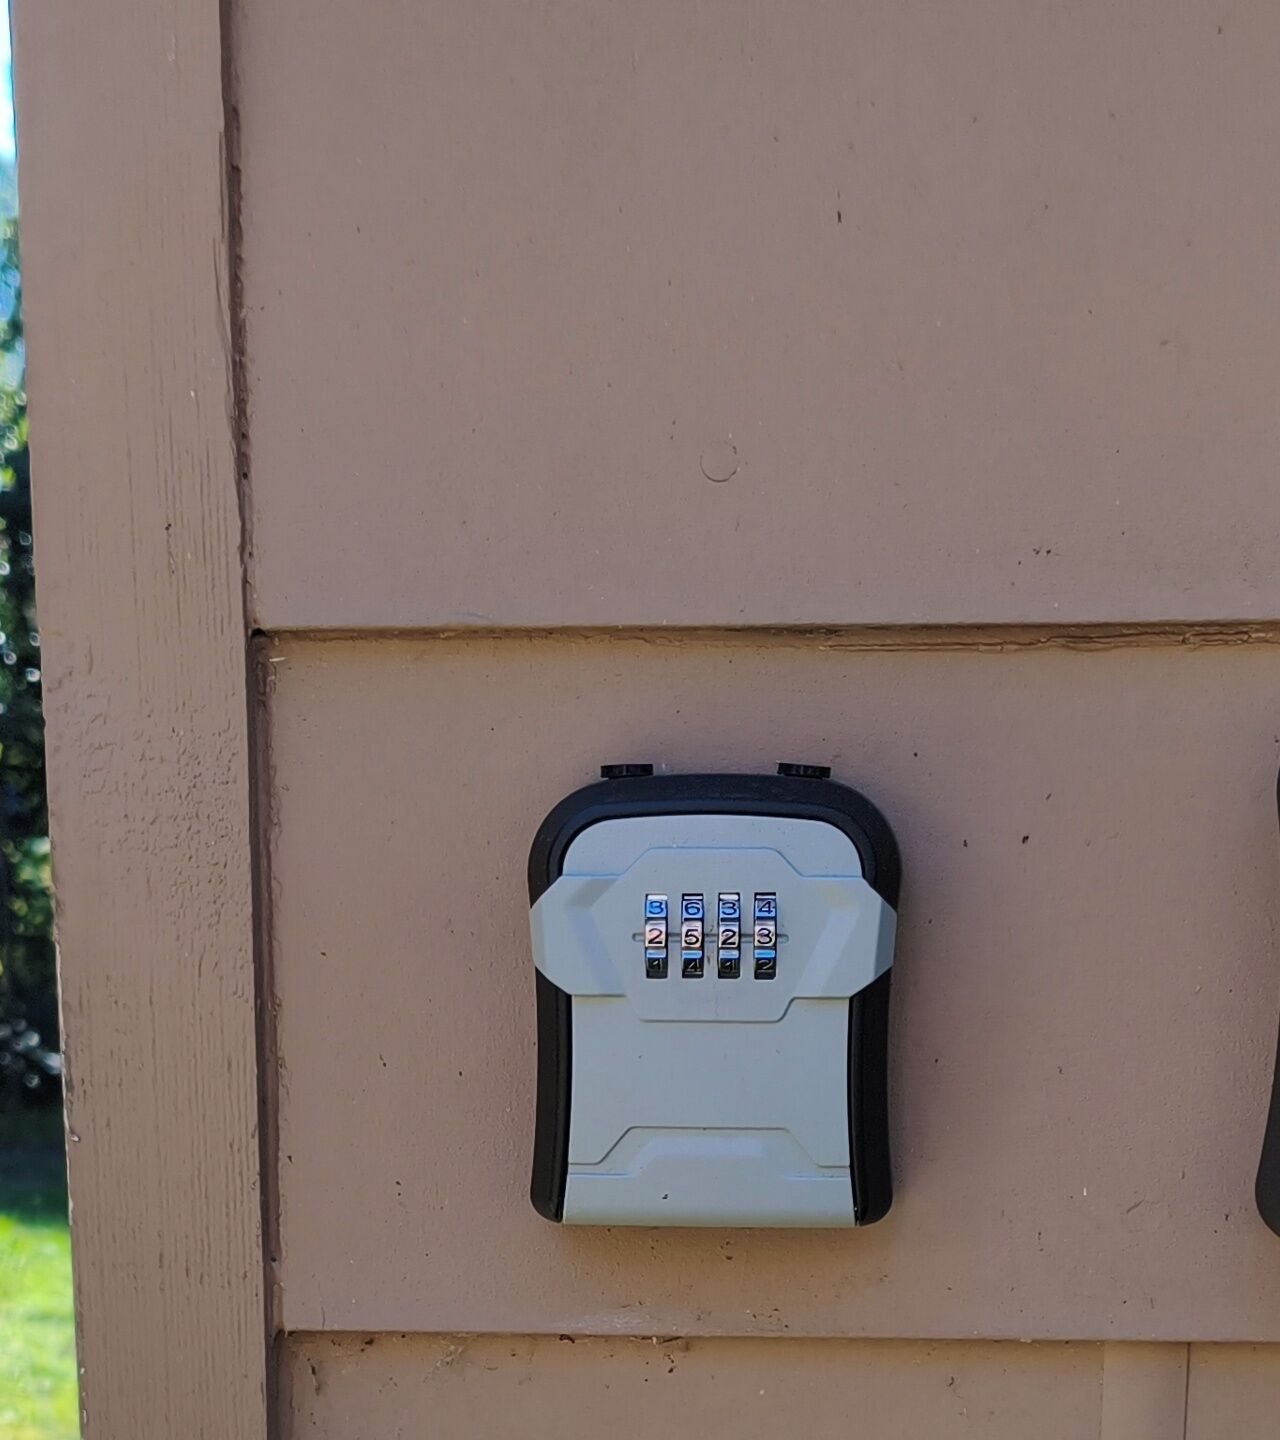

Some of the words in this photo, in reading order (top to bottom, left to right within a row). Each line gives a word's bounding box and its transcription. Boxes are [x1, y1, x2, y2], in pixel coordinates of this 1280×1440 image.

[648, 928, 663, 945] 2
[684, 928, 700, 946] 5
[721, 928, 737, 946] 2
[757, 928, 773, 945] 3
